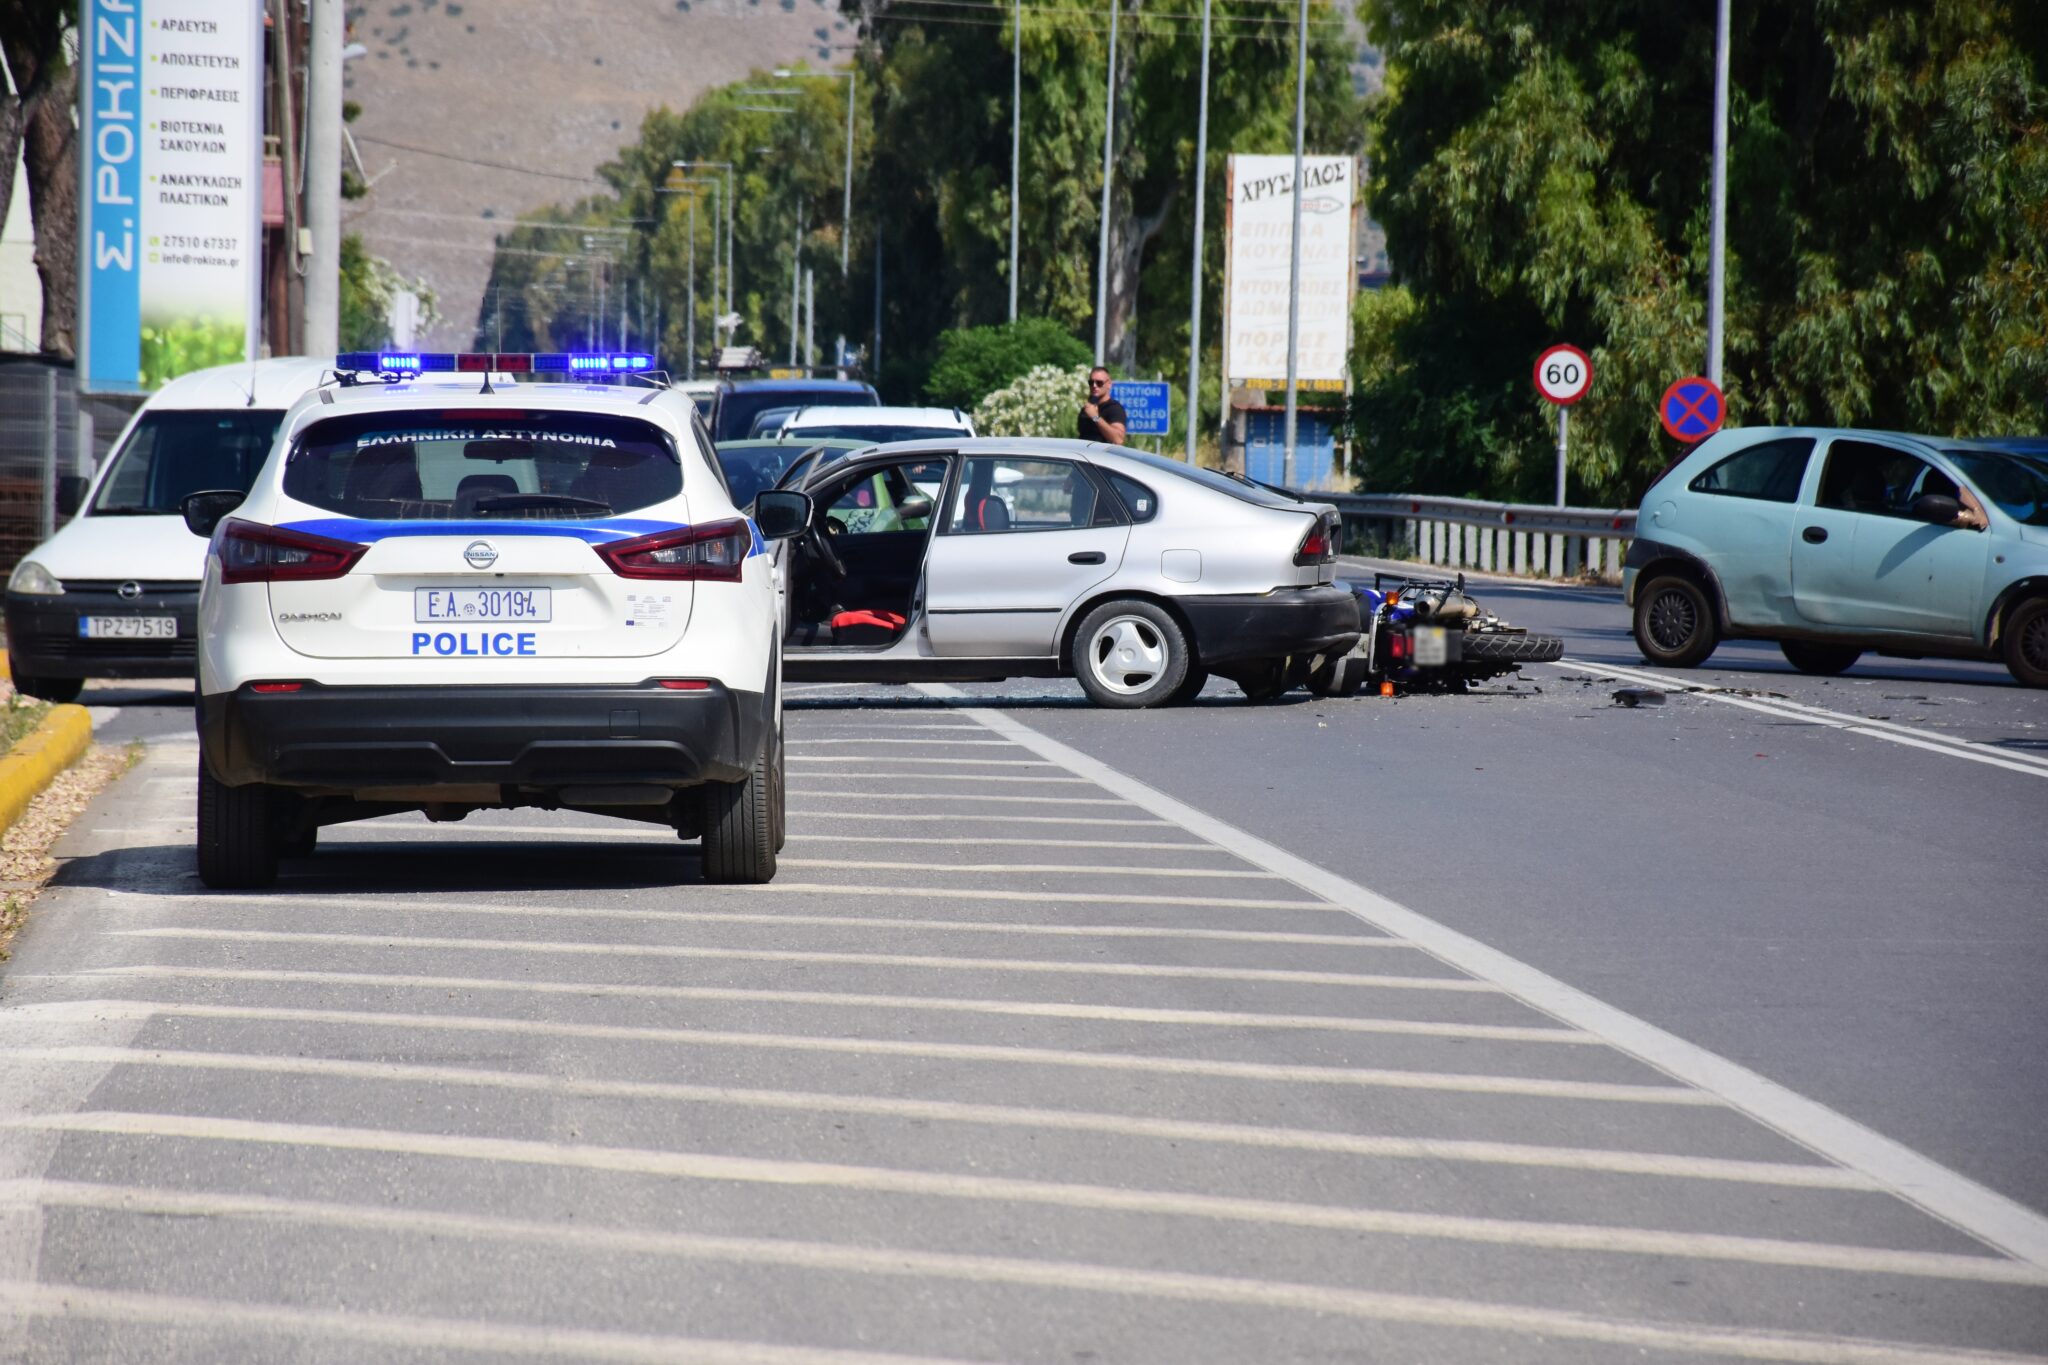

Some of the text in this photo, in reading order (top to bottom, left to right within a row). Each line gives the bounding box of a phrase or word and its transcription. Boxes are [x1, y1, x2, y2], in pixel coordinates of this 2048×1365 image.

[161, 19, 217, 34] ΑΡΔΕΥΣΗ
[161, 53, 240, 69] ΑΠΟΧΕΤΕΥΣΗ
[160, 87, 240, 103] ΠΕΡΙΦΡΑΞΕΙΣ
[160, 120, 224, 135] ΒΙΟΤΕΧΝΙΑ
[160, 138, 226, 153] ΣΑΚΟΥΛΩΝ
[160, 174, 242, 189] ΑΝΑΚΥΚΛΩΣΗ
[1241, 161, 1345, 203] ΧΡΥΣΥΛΟΣ
[160, 192, 229, 207] ΠΛΑΣΤΙΚΩΝ
[96, 218, 134, 271] Σ.
[163, 235, 237, 250] 27510 67337
[1240, 243, 1344, 259] ΚΟΥΖΝΑΣ
[1236, 331, 1328, 349] ΠΟΡΕΣ
[1546, 363, 1579, 385] 60
[1113, 386, 1161, 397] TENTION
[1125, 408, 1167, 419] ROLLED
[1128, 419, 1158, 430] ADAR
[357, 429, 616, 448] ΕΛΛΗΝΙΚΗ ΑΣΤΥΝΟΜΙΑ
[478, 591, 537, 617] 30194
[412, 632, 537, 656] POLICE
